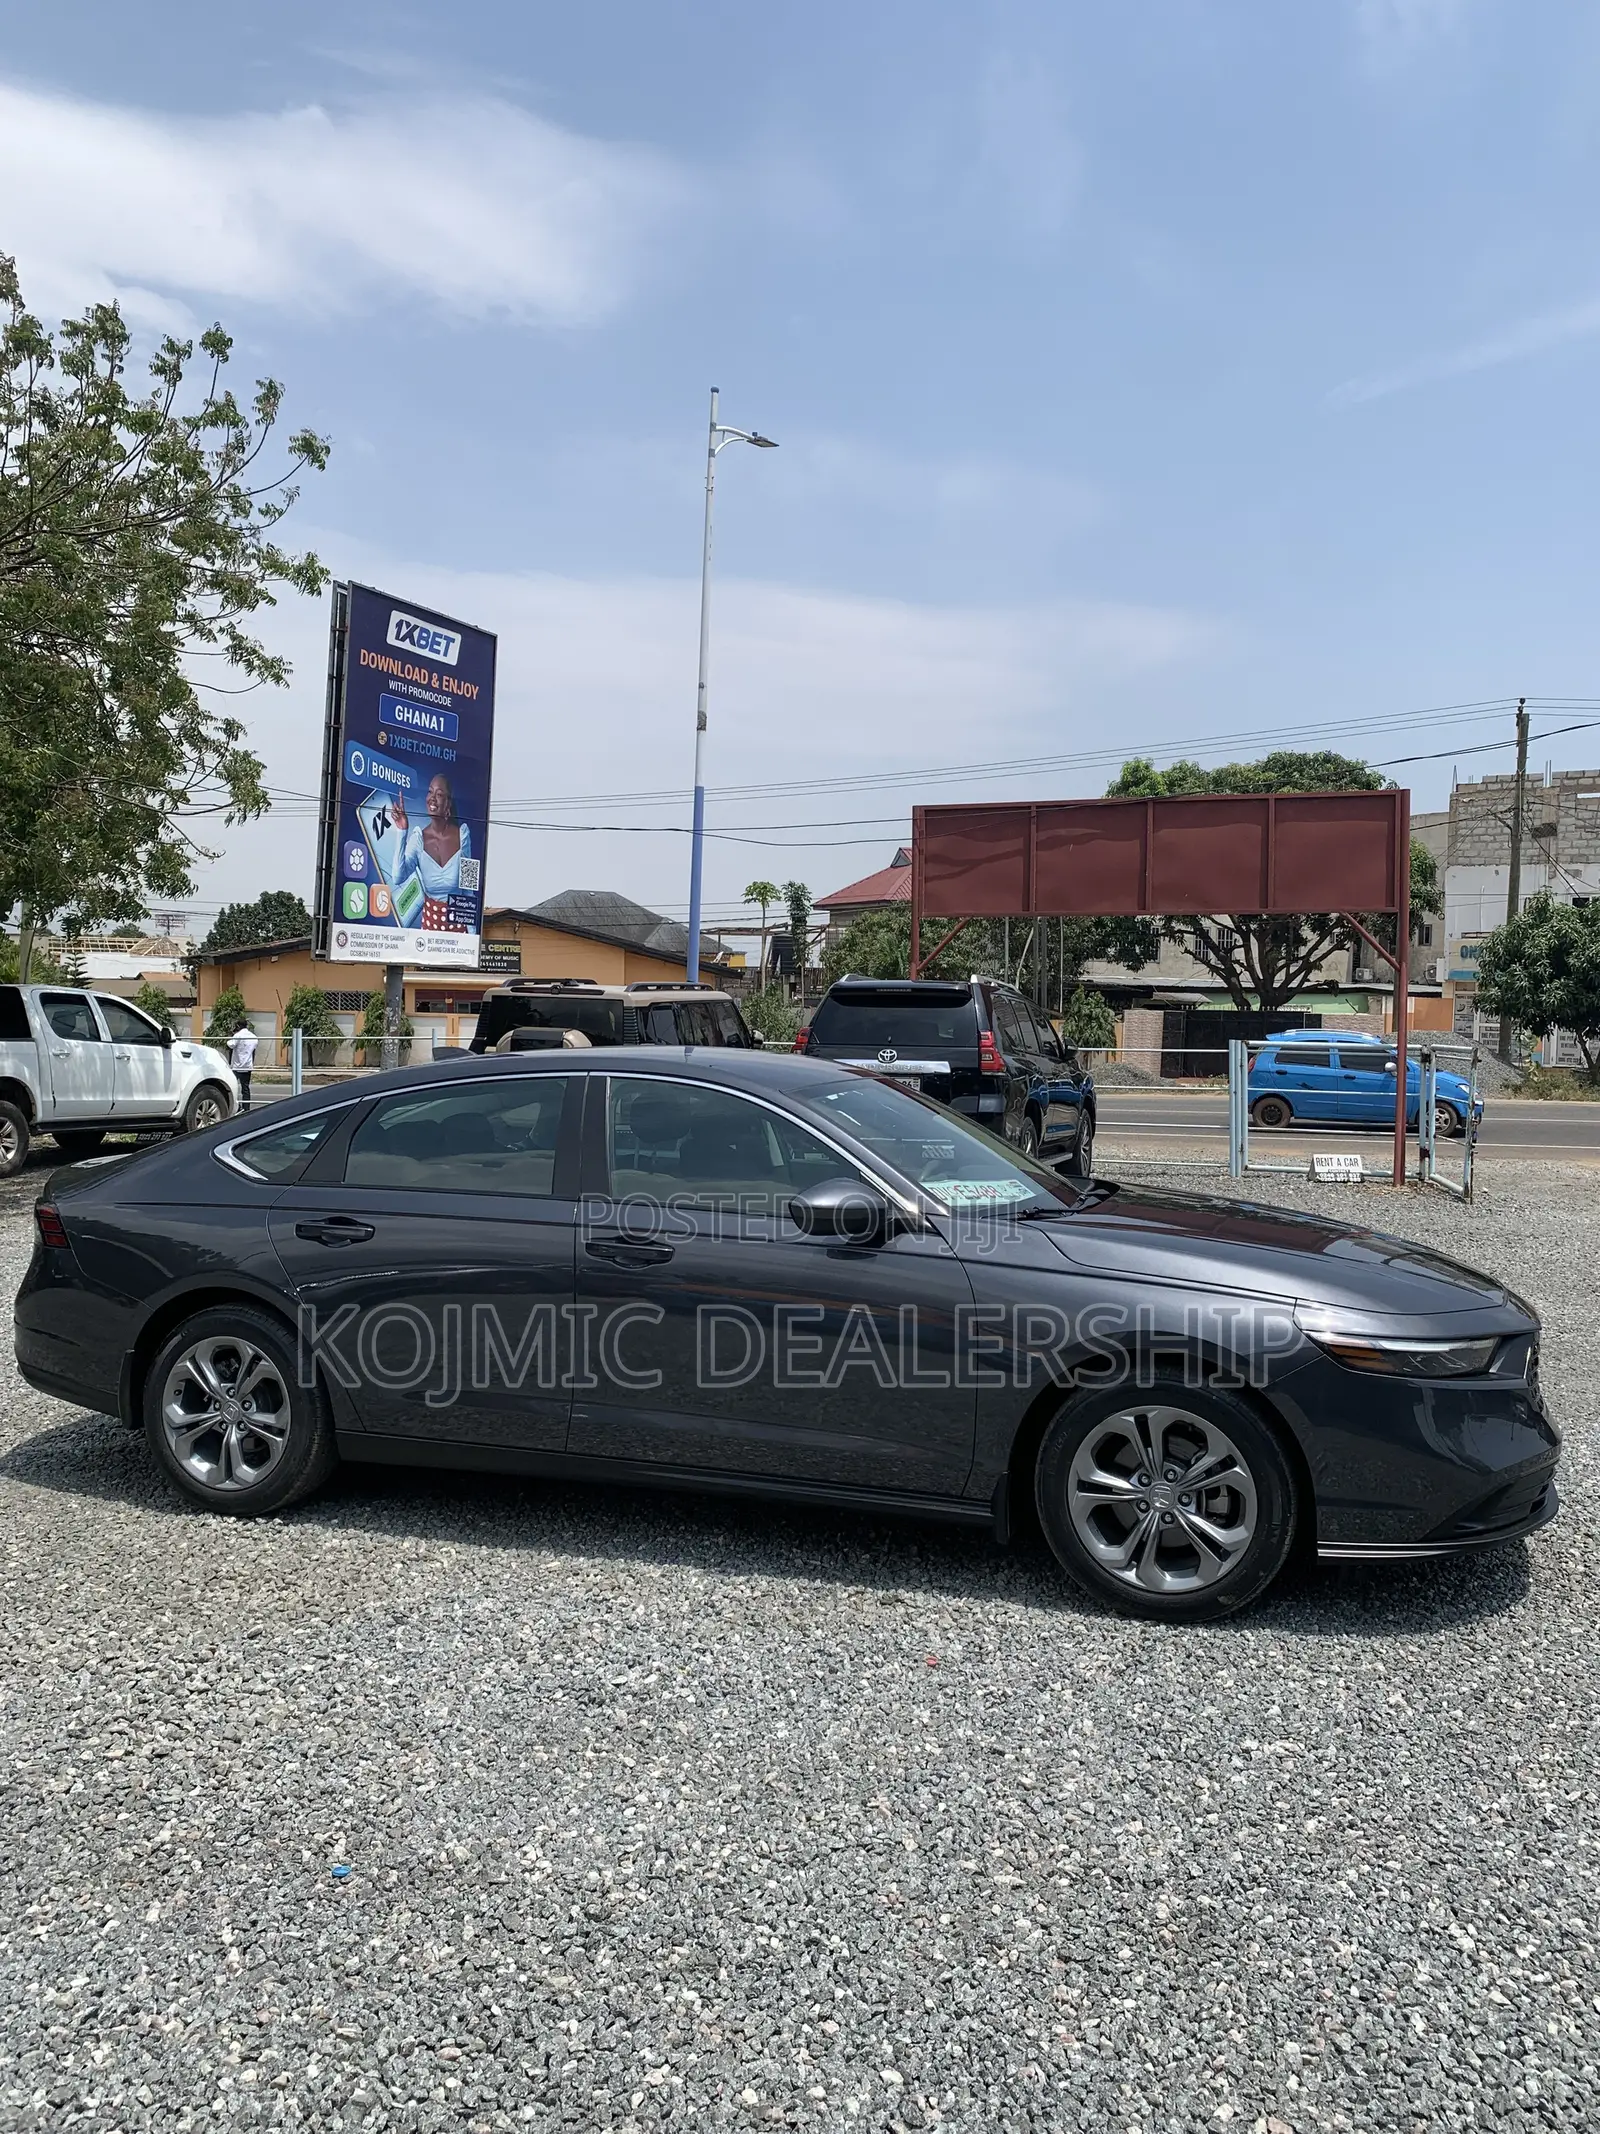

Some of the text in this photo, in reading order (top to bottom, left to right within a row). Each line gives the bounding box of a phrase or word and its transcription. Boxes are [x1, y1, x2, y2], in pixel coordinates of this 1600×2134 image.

[394, 618, 456, 658] 1XBET
[360, 648, 480, 700] DOWNLOAD & ENJOY
[388, 679, 452, 707] WITH PROMOCODE
[394, 705, 445, 732] GHANA1
[388, 733, 457, 763] 1XBET.COM.GH
[371, 761, 411, 789] BONUSES
[350, 932, 375, 940] REGULATED
[350, 940, 378, 949] COMMISSION
[488, 944, 521, 953] CENTRE
[1315, 1157, 1360, 1167] RENT A CAR
